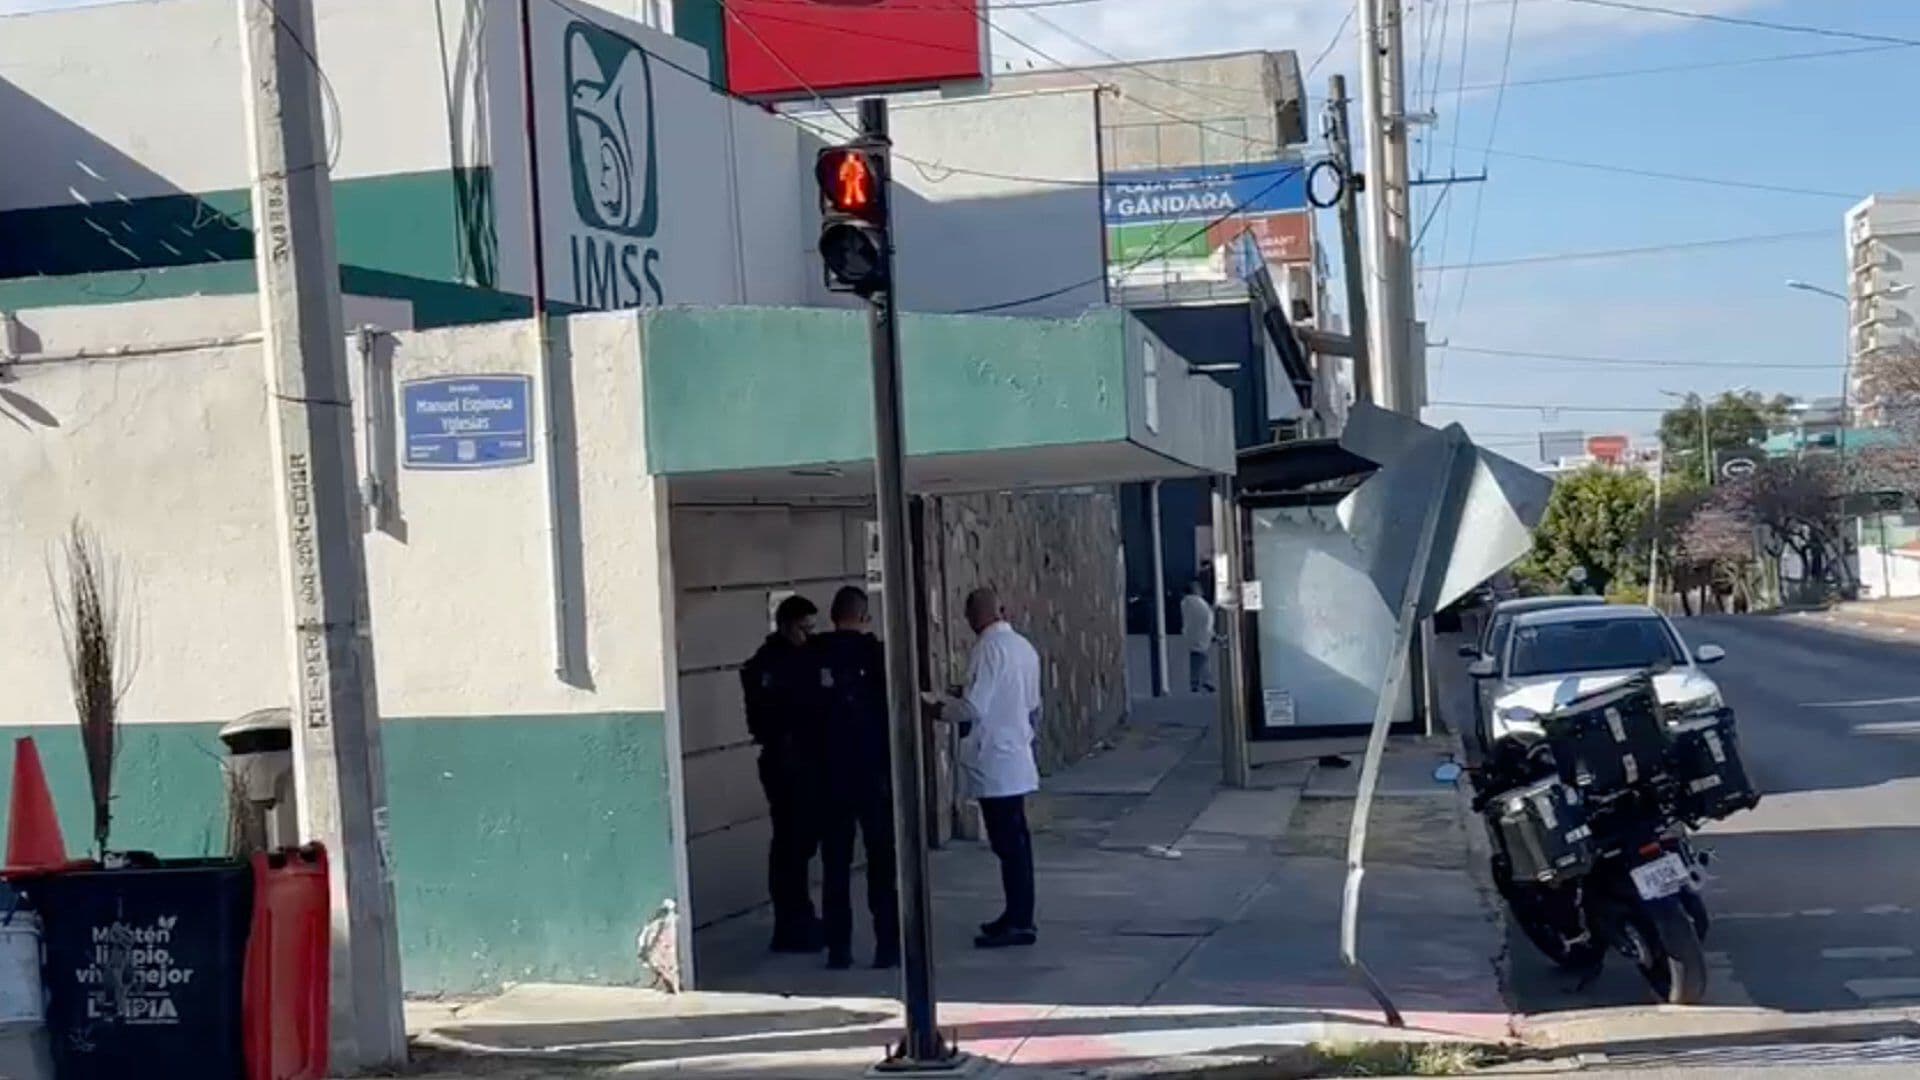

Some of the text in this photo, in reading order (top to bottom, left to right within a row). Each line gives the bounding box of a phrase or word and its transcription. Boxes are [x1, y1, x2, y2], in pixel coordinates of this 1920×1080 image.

[571, 235, 663, 309] IMSS
[416, 397, 513, 413] Manuel Espinosa
[441, 417, 490, 435] Yglesias
[92, 925, 170, 942] Mtén
[96, 945, 174, 967] lipio,
